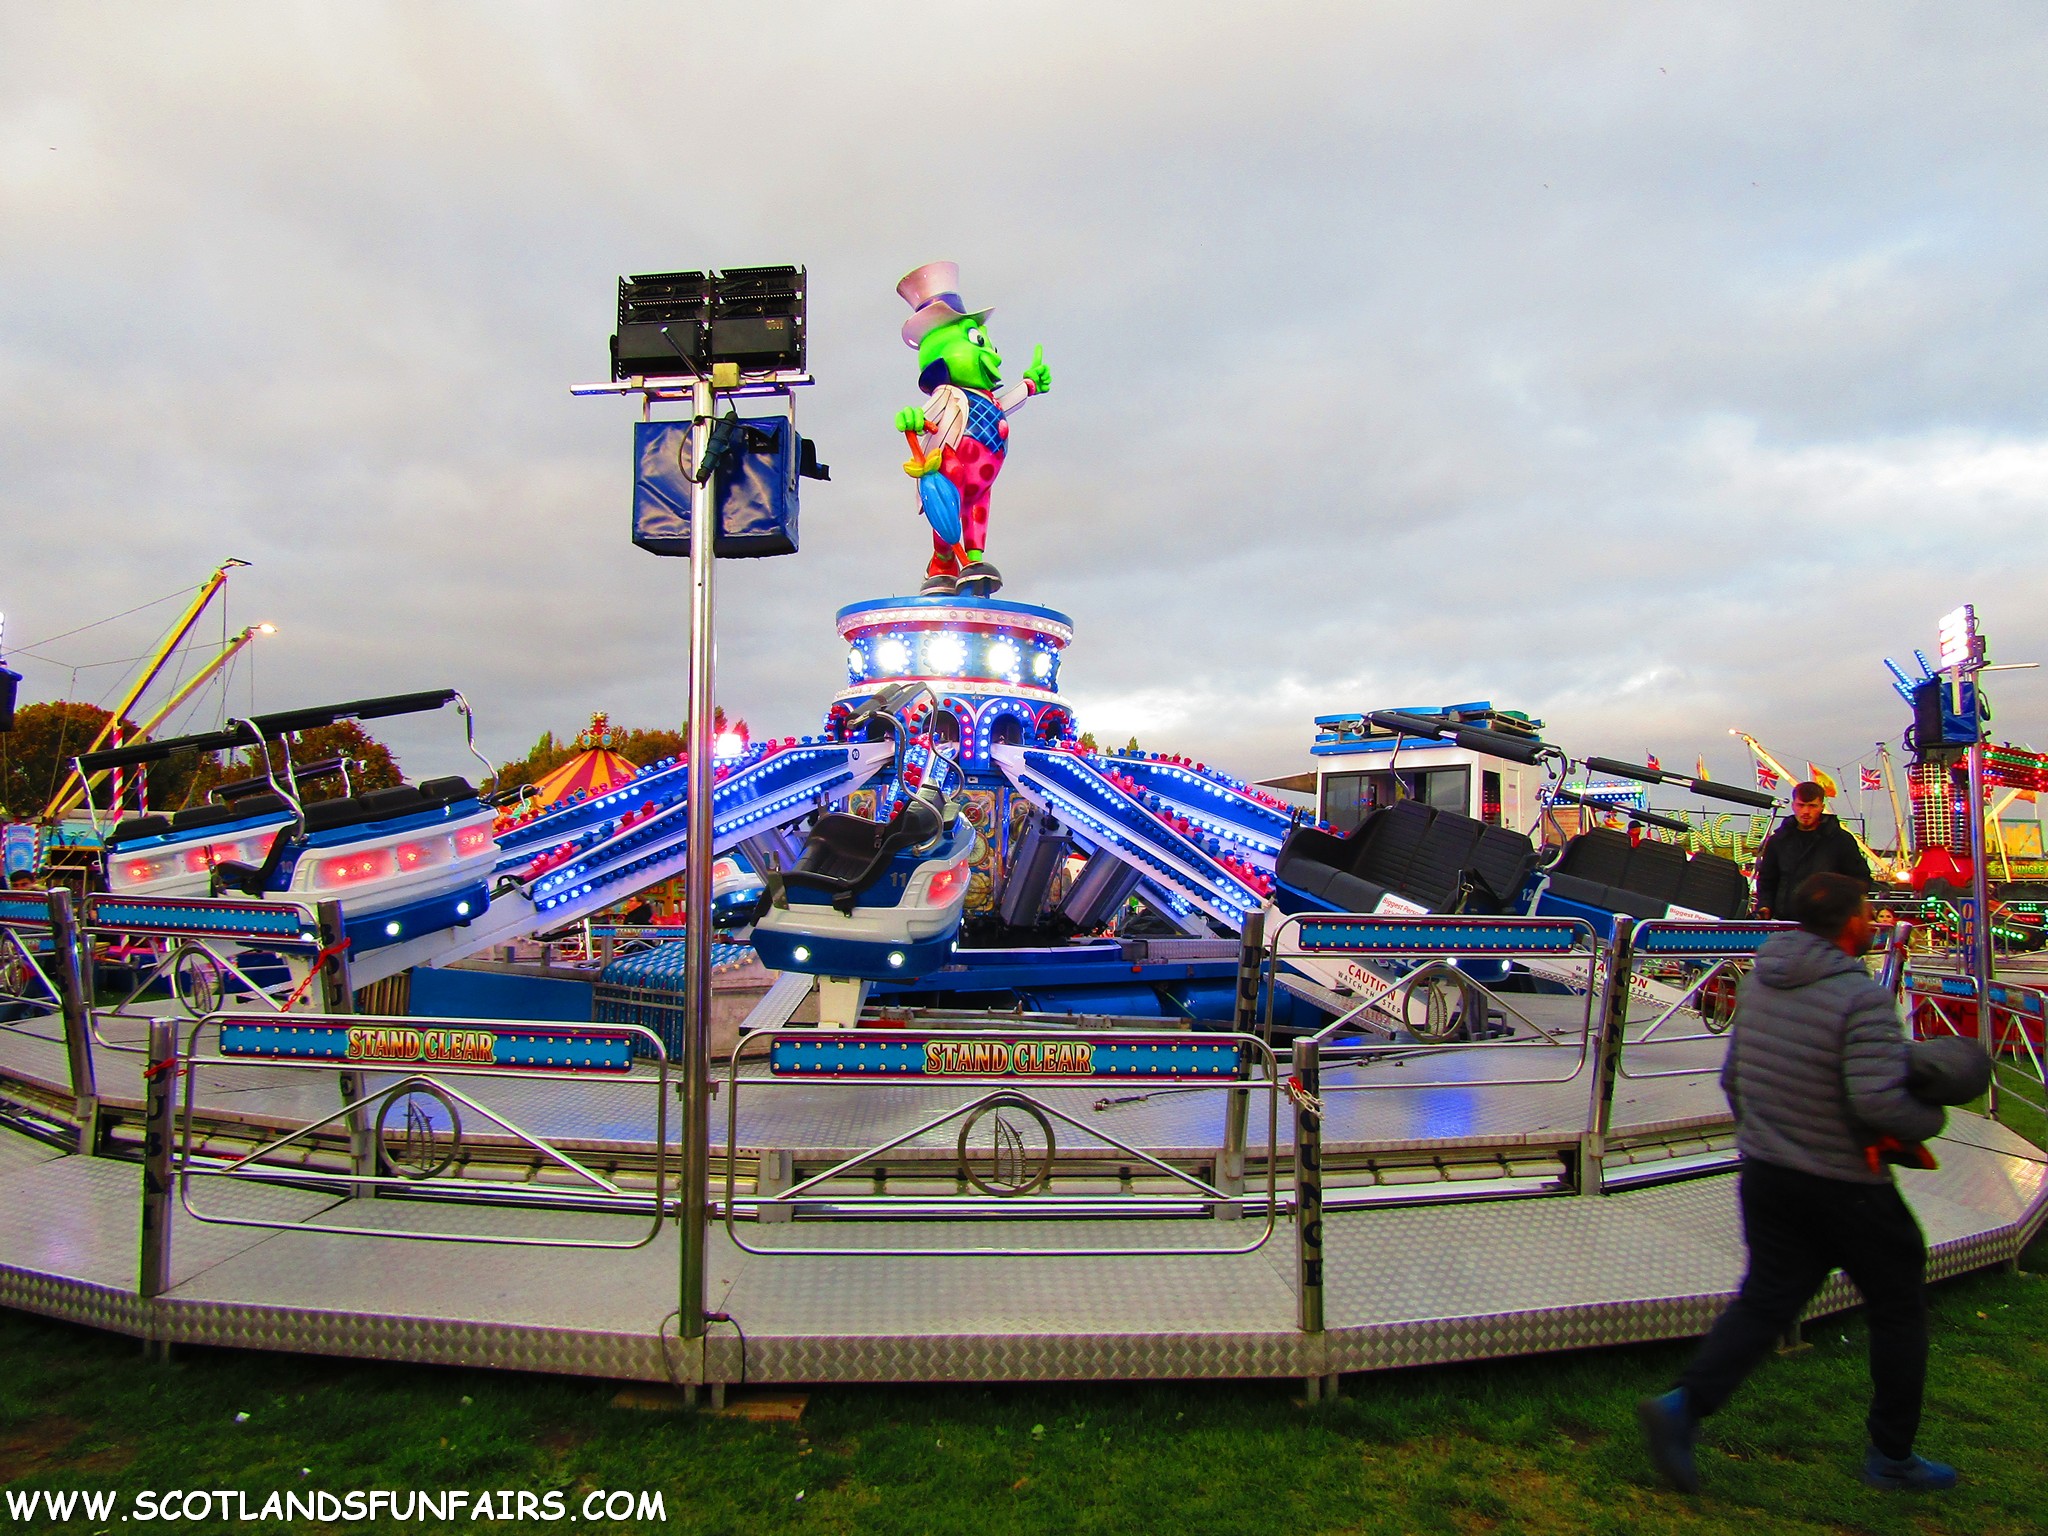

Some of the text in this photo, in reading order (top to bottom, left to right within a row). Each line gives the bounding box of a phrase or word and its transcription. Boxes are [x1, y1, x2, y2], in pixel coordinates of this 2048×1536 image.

[281, 861, 294, 873] 10
[890, 872, 907, 887] 11
[1522, 888, 1534, 902] 12
[1382, 897, 1403, 910] Biggest
[1669, 907, 1693, 918] Biggest
[1337, 970, 1362, 991] WATCH
[1381, 998, 1401, 1014] STEP
[347, 1029, 495, 1062] STAND CLEAR
[926, 1042, 1092, 1074] STAND CLEAR
